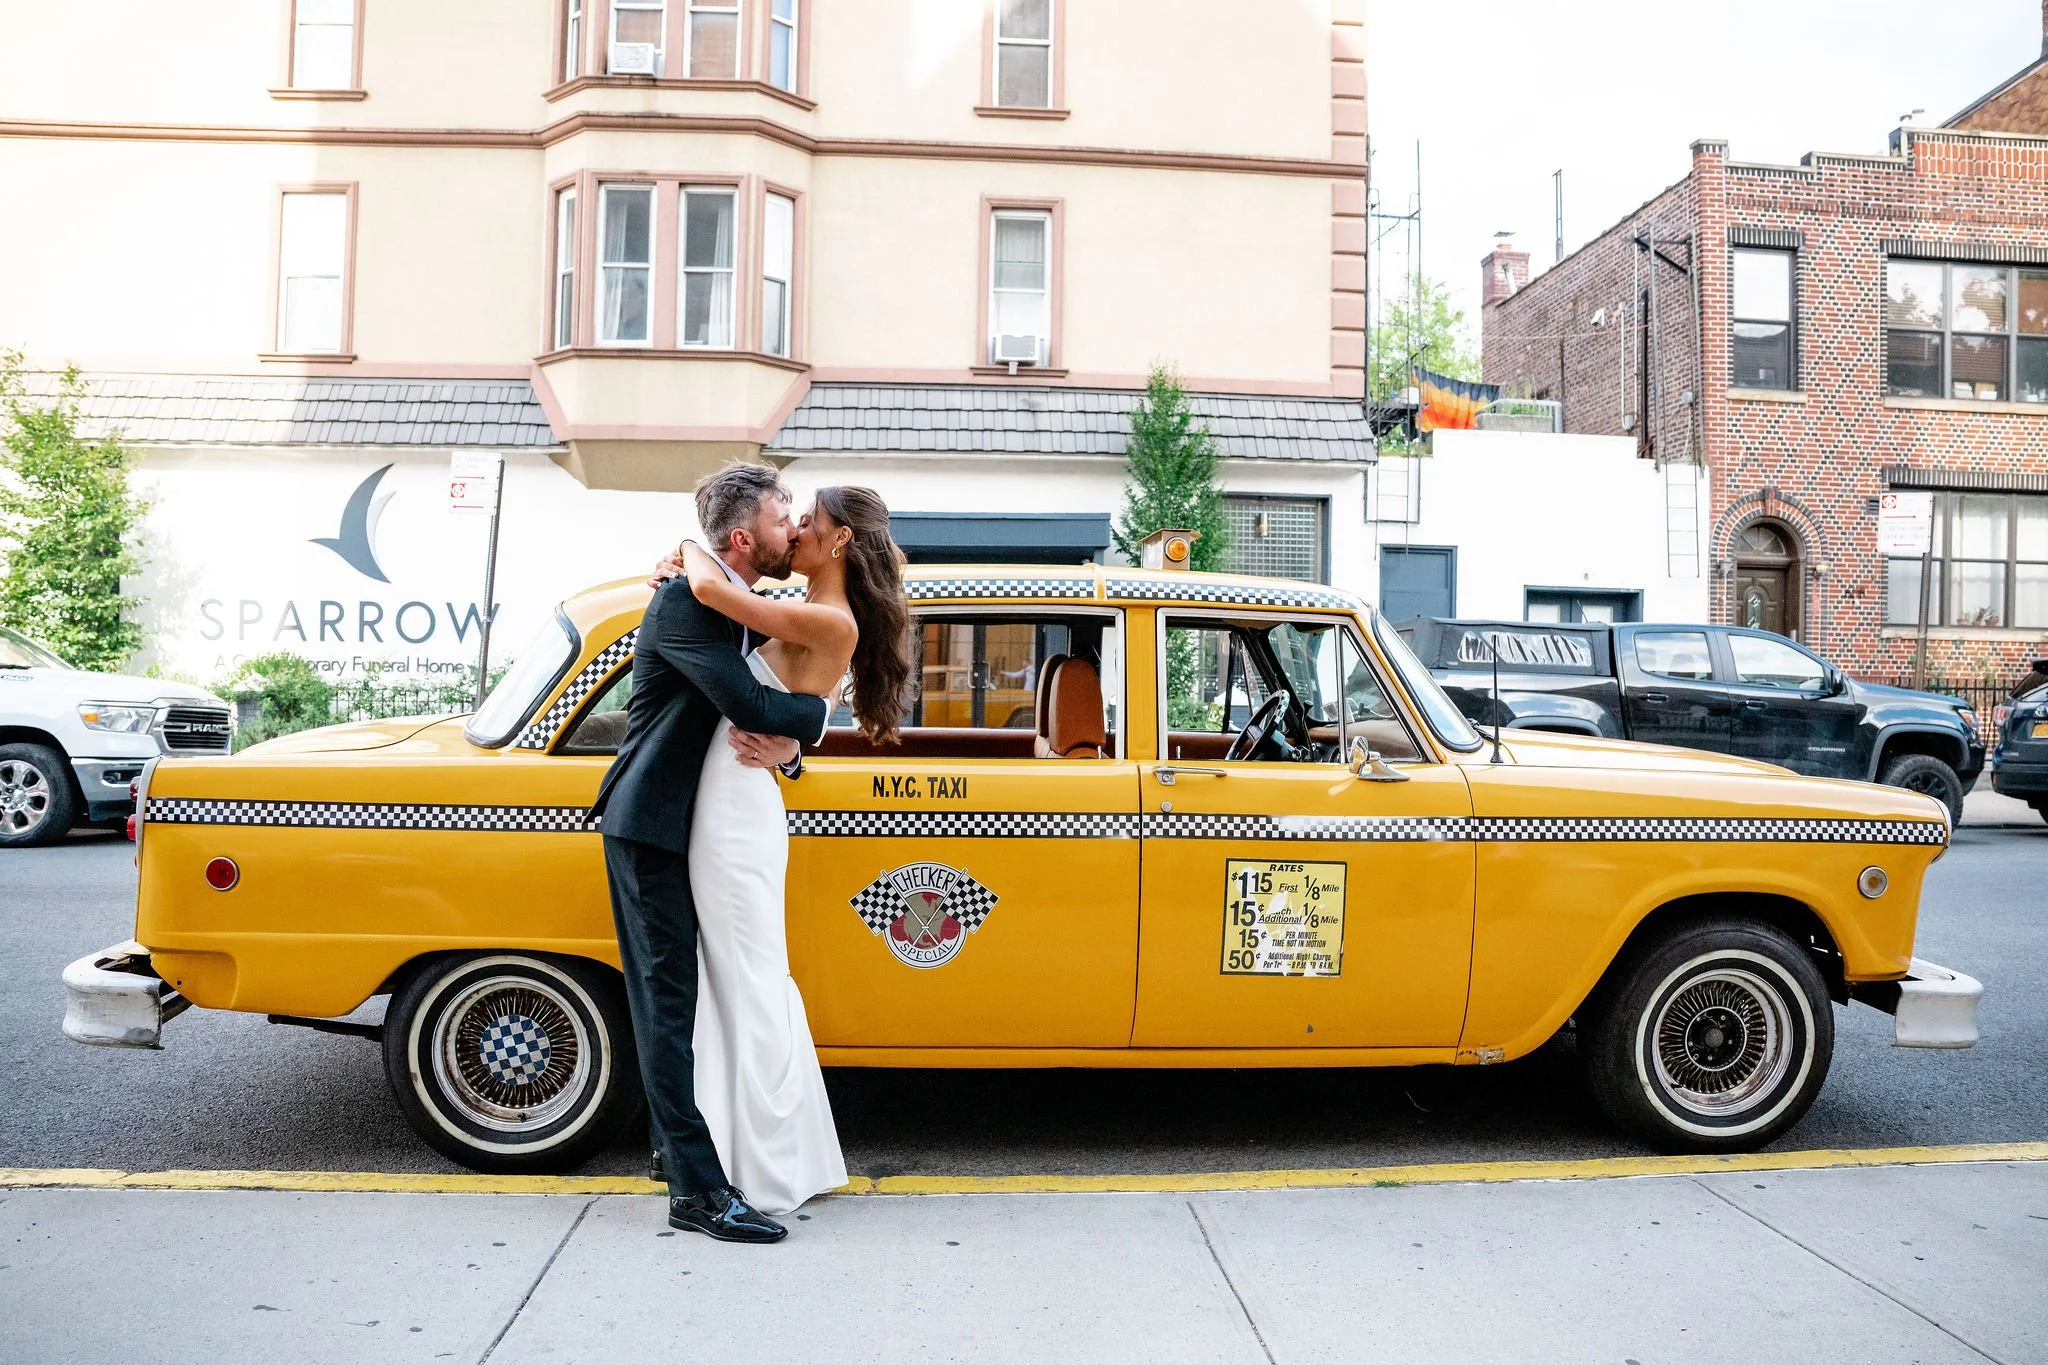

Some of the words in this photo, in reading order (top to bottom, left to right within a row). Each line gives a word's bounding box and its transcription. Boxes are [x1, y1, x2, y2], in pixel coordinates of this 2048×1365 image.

[200, 598, 501, 644] SPARROW
[214, 654, 229, 670] A
[353, 656, 410, 673] Funeral
[416, 657, 465, 674] Home
[192, 723, 223, 732] RAM
[872, 775, 922, 798] N.Y.C.
[927, 776, 968, 799] TAXI
[1269, 864, 1304, 873] RATES
[892, 866, 956, 892] CHECKER
[1278, 883, 1299, 892] First
[1321, 884, 1340, 893] Mile
[1258, 914, 1303, 924] Additional
[1320, 915, 1339, 925] Mile
[1285, 931, 1296, 939] PER
[1297, 931, 1318, 940] MINUTE
[1305, 940, 1327, 948] MOTION
[899, 942, 954, 961] SPECIAL
[1267, 951, 1295, 960] Additional
[1295, 952, 1311, 961] Night
[1312, 952, 1332, 962] Charge
[1262, 960, 1274, 969] Per
